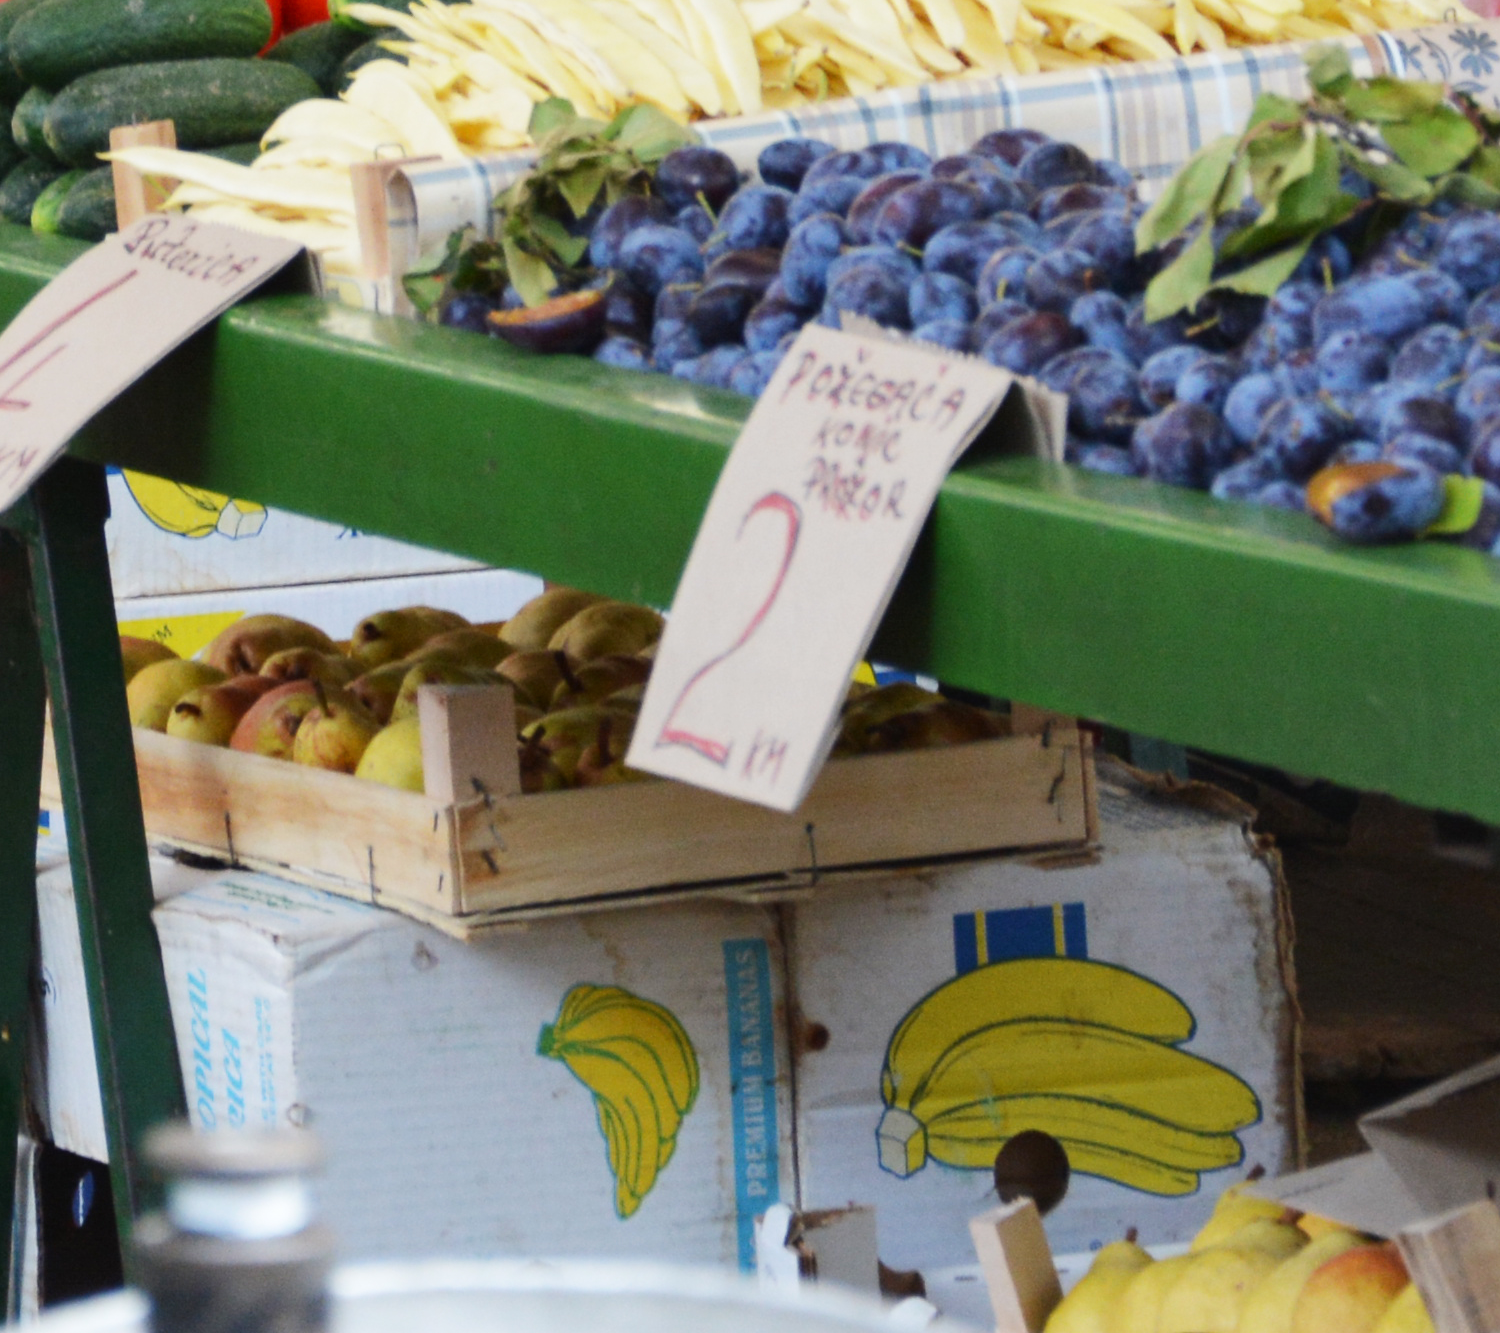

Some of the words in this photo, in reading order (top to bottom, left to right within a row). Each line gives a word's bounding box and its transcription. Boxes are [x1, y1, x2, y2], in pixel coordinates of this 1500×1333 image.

[653, 491, 802, 767] 2
[185, 966, 217, 1133] OPICAL
[734, 948, 764, 1069] BANANAS
[741, 1075, 771, 1197] PREMIUM
